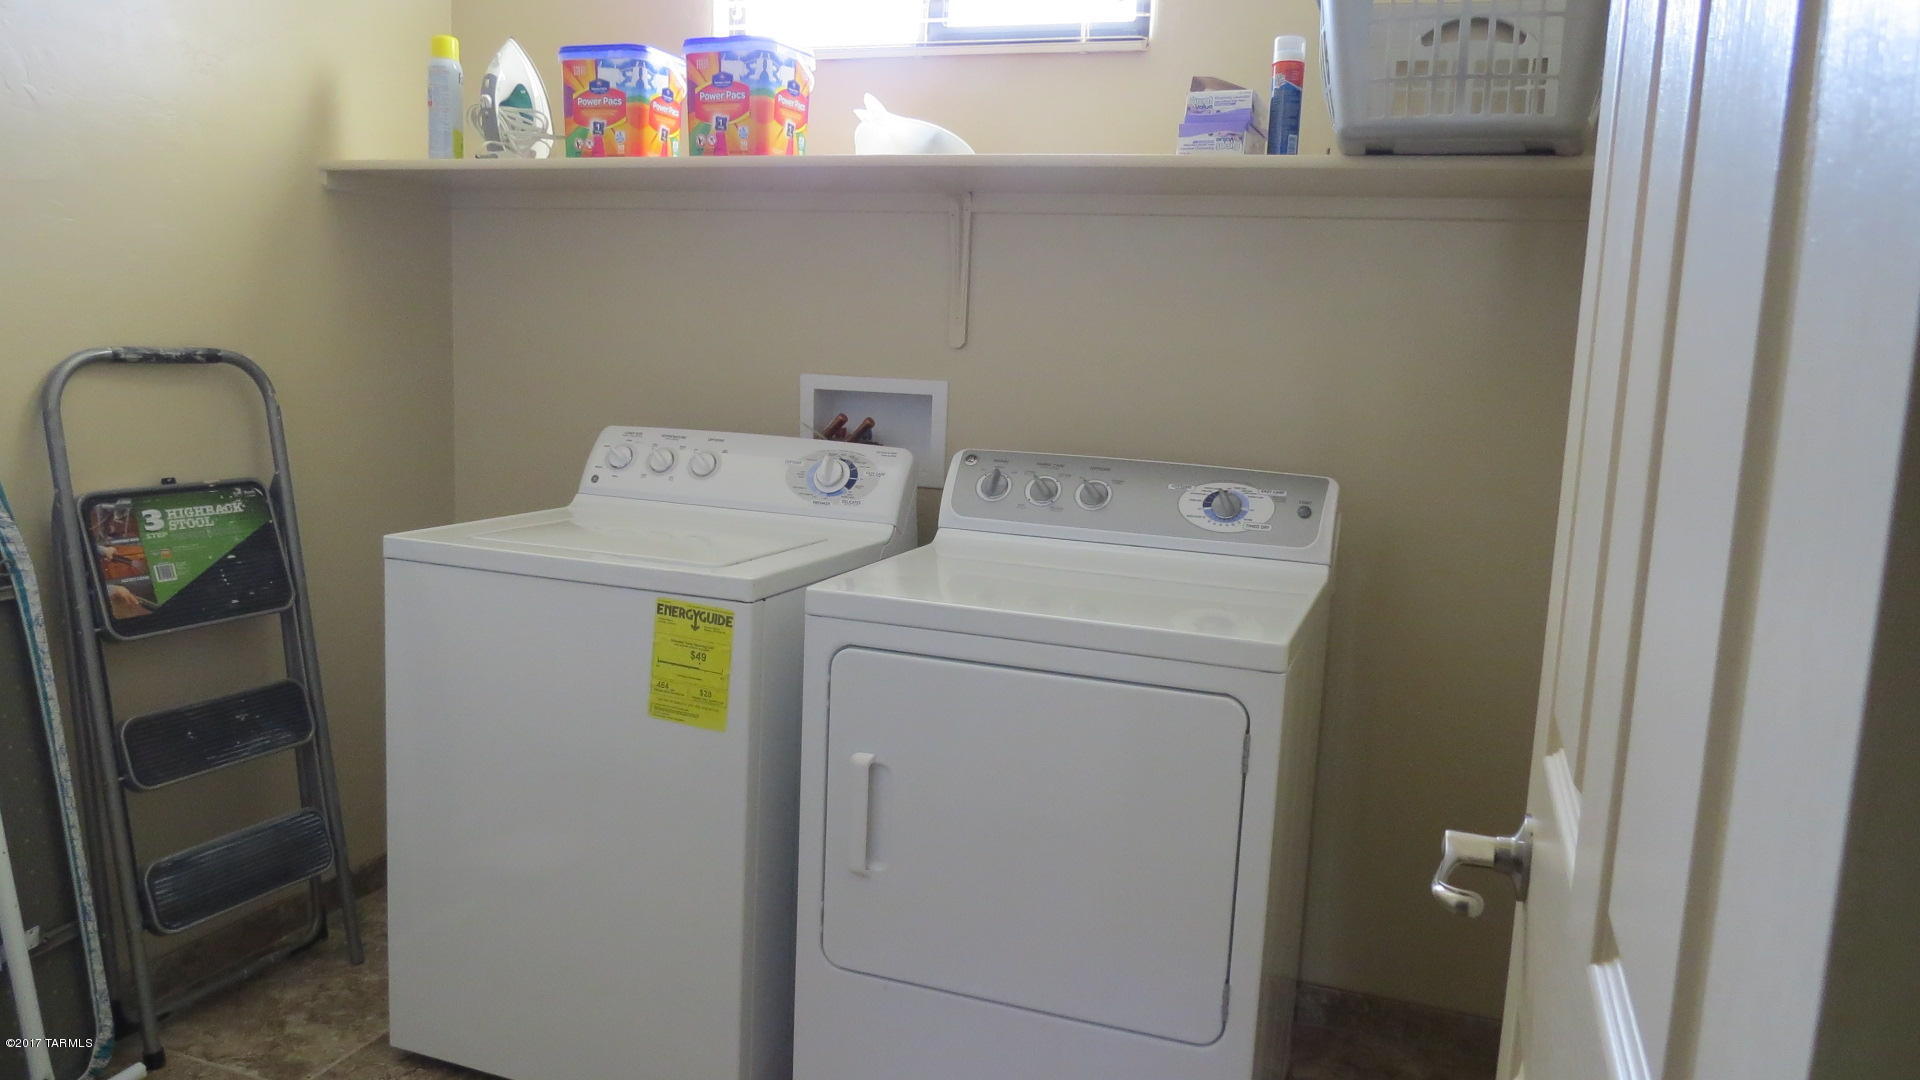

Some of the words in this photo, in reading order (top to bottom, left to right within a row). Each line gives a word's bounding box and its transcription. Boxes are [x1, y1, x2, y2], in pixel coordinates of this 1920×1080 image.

[577, 97, 602, 107] Power
[603, 97, 623, 106] Pacs
[699, 91, 725, 101] Power
[726, 91, 746, 100] Pacs
[777, 94, 794, 108] Power
[165, 502, 244, 519] HIGHBACK
[141, 509, 165, 531] 3
[168, 516, 215, 530] STOOL
[145, 531, 168, 540] STEP
[656, 603, 734, 628] ENERGYGUIDE
[690, 651, 707, 662] $49
